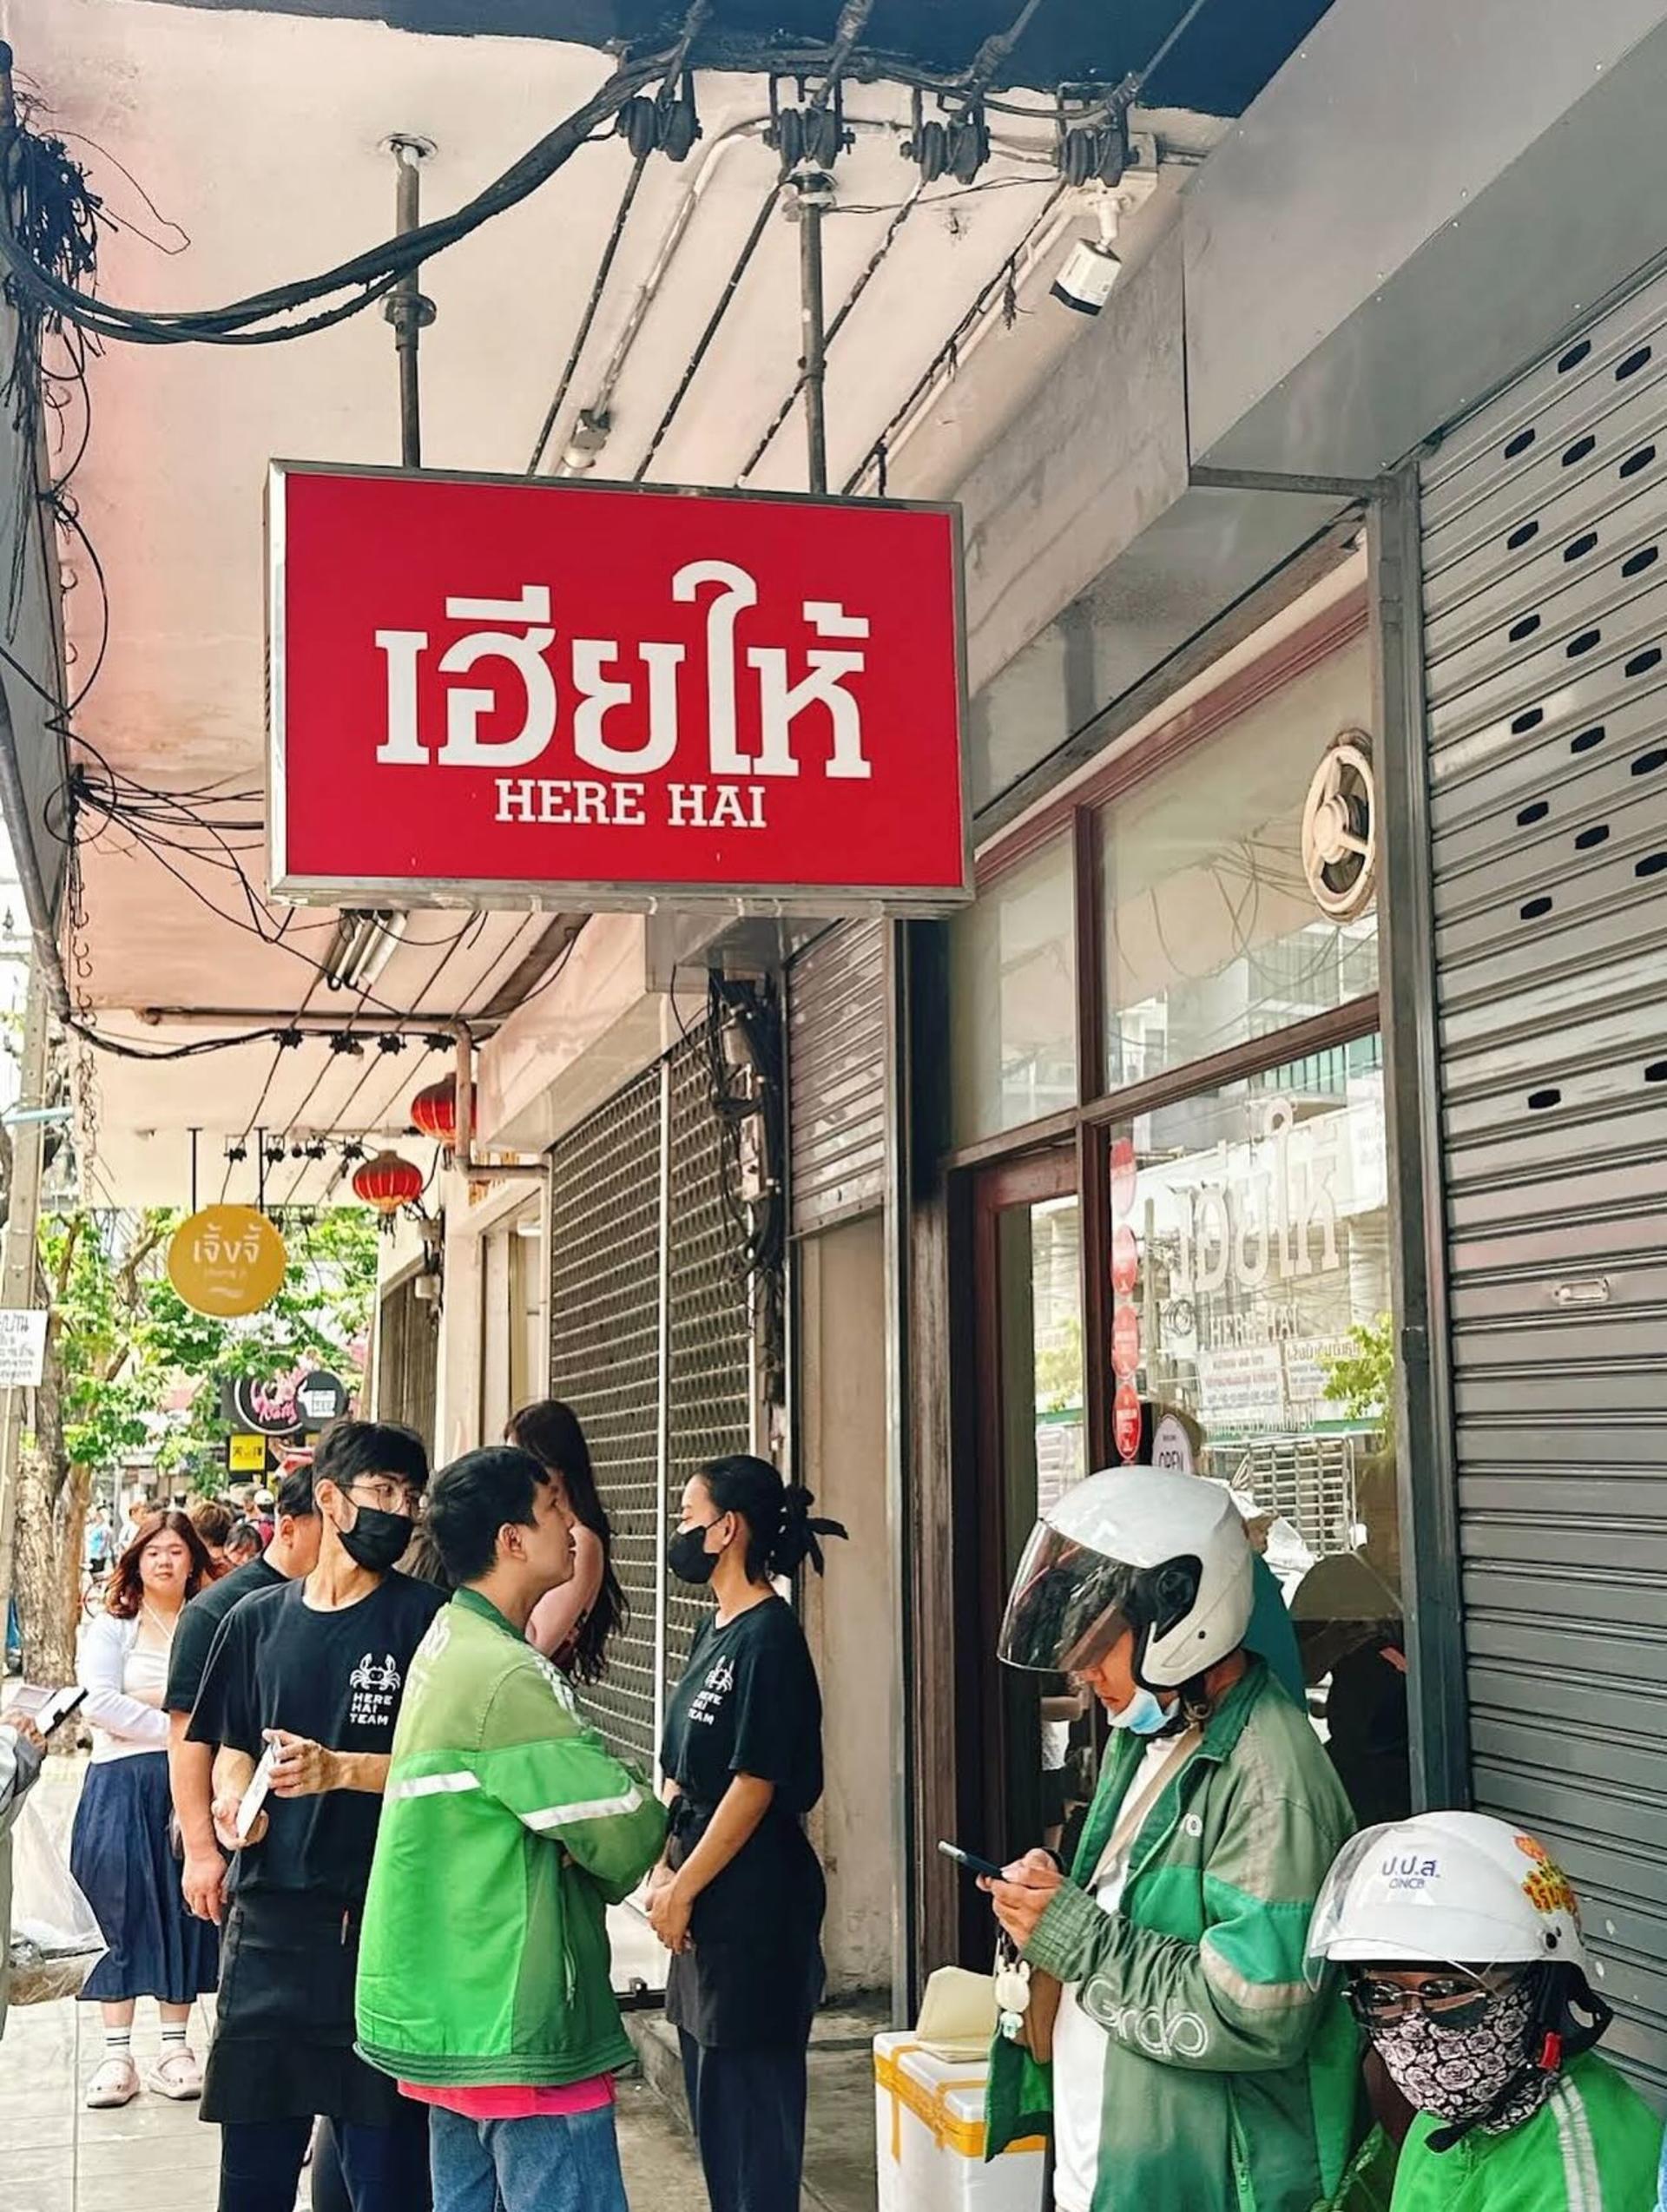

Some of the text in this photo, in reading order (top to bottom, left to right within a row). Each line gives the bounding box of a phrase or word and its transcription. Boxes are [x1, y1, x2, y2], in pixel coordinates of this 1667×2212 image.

[374, 560, 871, 779] เฮียให้
[495, 778, 768, 829] HERE HAI
[353, 1692, 393, 1705] HERE
[352, 1702, 378, 1714] HAI
[349, 1713, 389, 1726] TEAM
